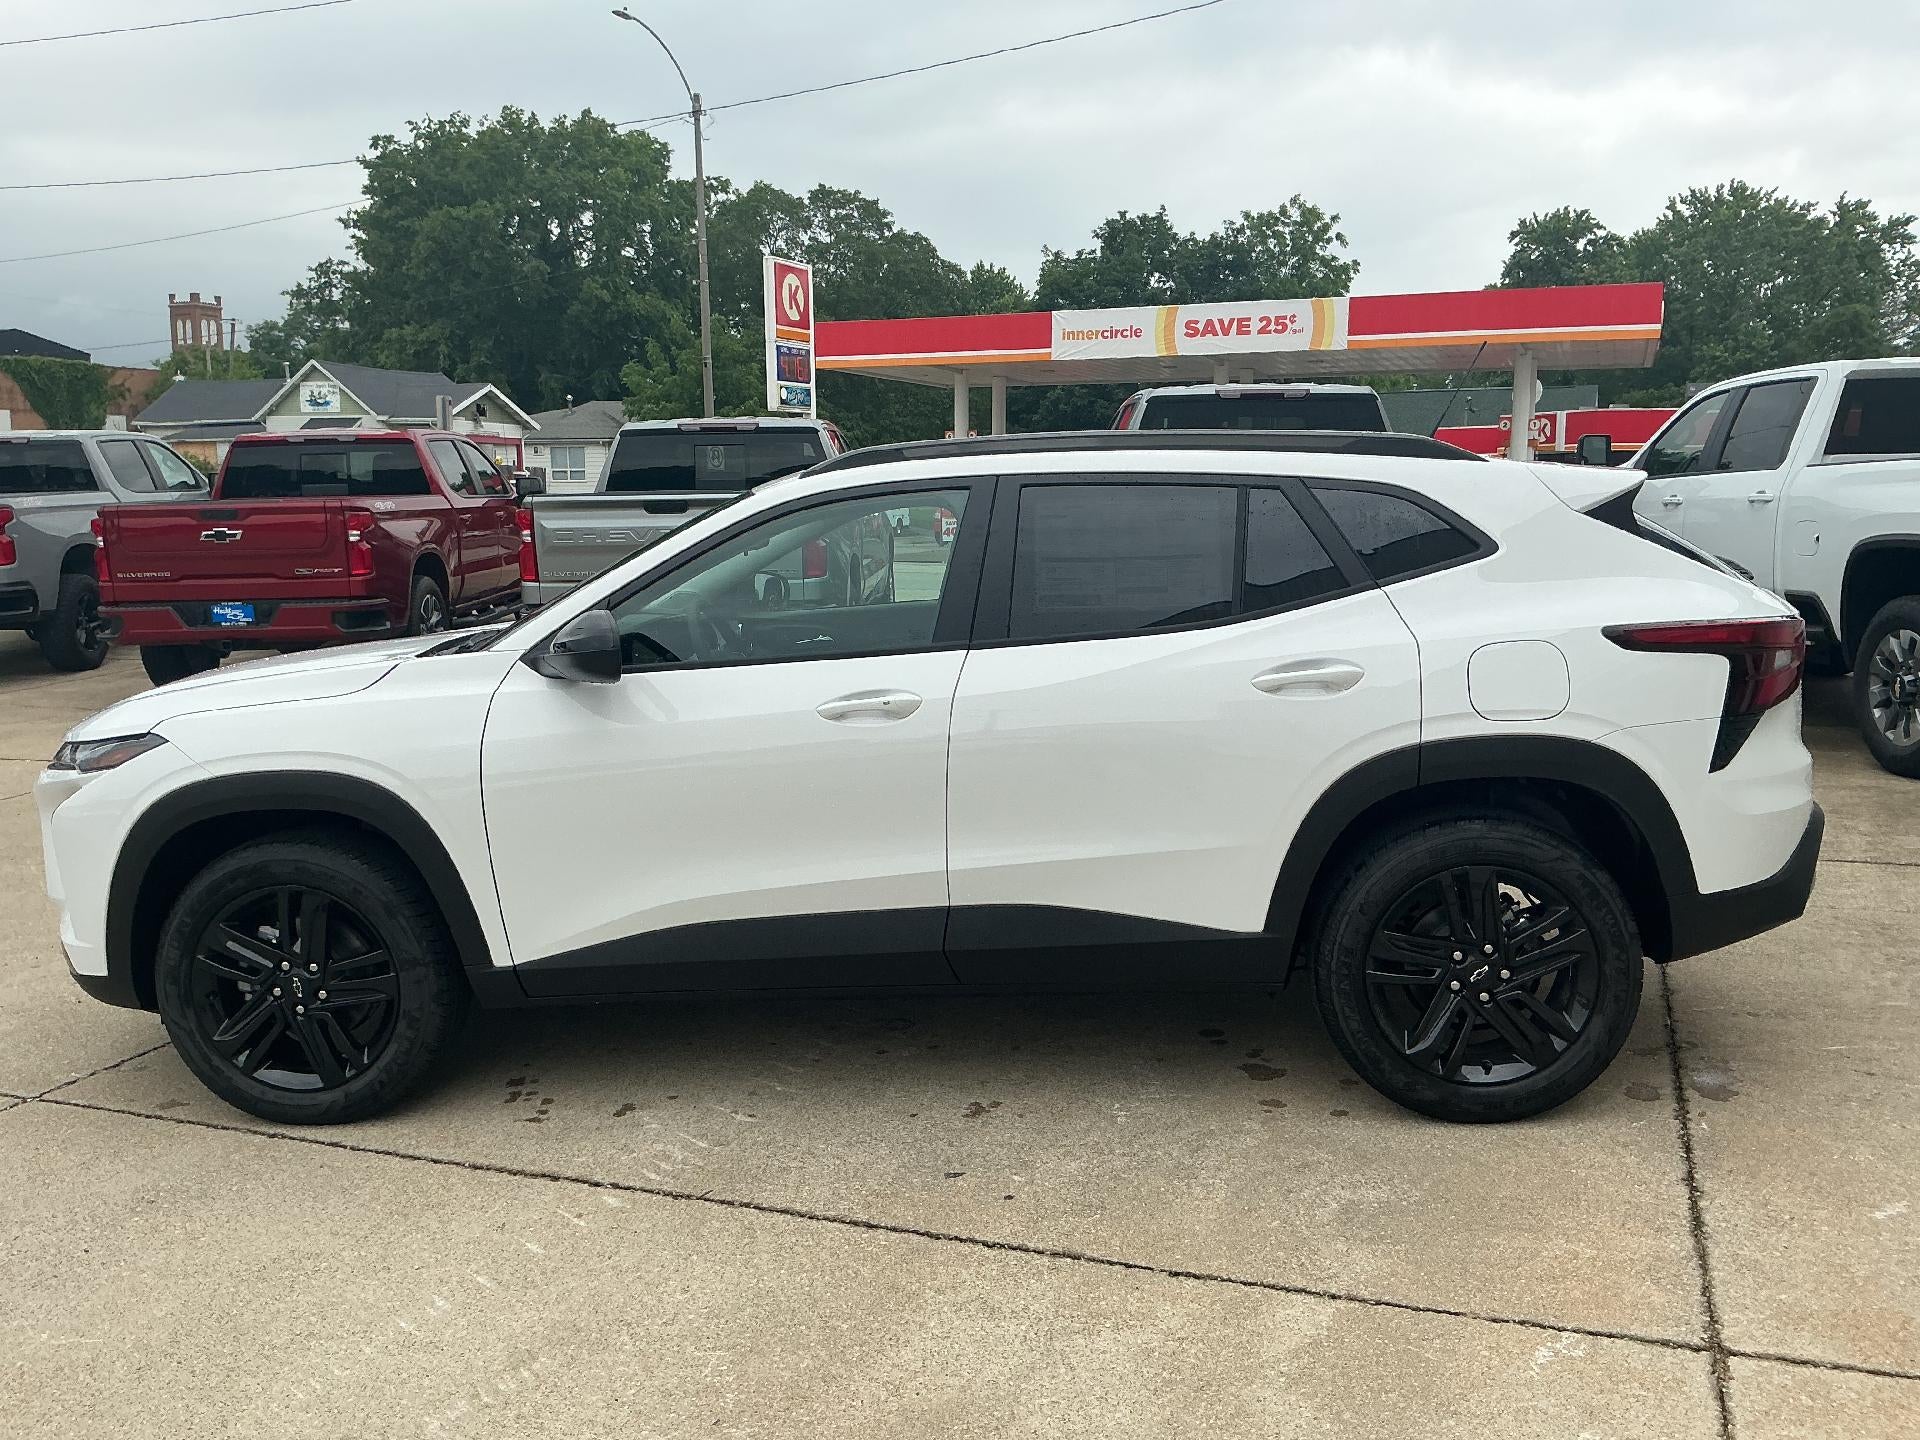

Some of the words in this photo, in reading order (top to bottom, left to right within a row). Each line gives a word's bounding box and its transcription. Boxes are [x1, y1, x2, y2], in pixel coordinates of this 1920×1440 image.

[788, 283, 801, 317] K
[1062, 325, 1143, 340] innercircle
[1184, 317, 1252, 338] SAVE
